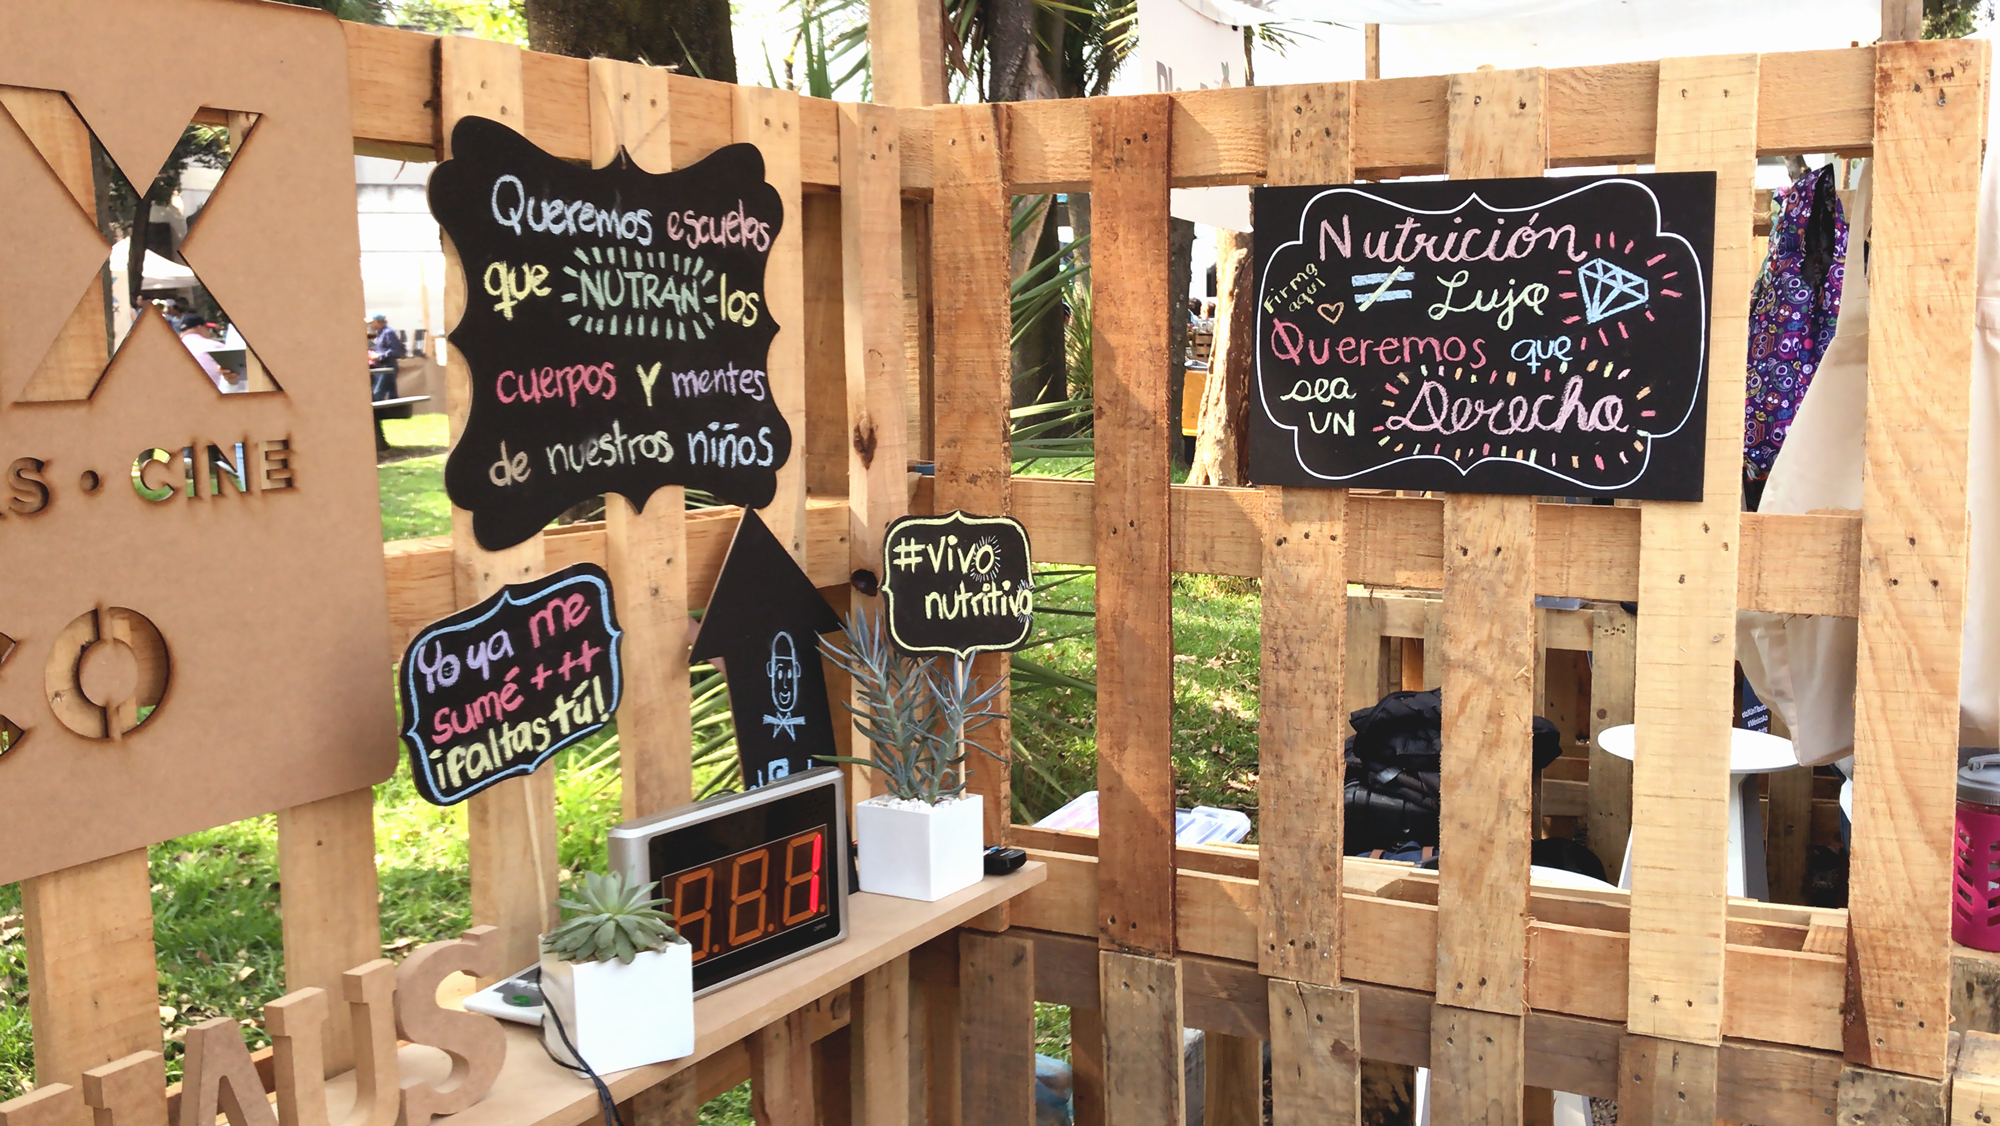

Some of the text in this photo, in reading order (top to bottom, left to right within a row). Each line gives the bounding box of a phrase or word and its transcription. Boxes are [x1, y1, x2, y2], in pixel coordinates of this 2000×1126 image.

[491, 173, 771, 252] Queremos escuelas
[1318, 212, 1588, 263] Nutrición
[483, 260, 760, 327] que NUTRAN los
[1263, 263, 1318, 315] Firma
[1428, 269, 1550, 331] Lujo
[1271, 318, 1574, 374] Queremos que
[496, 361, 617, 407] cuerpos
[671, 361, 766, 401] mentes
[1279, 376, 1357, 403] sea
[1385, 375, 1630, 436] Derecho
[1308, 409, 1356, 437] UN
[0, 438, 294, 516] S CINE
[489, 420, 774, 488] de nuestros niños
[924, 579, 1034, 620] nutritivo
[417, 592, 592, 694] Yo ya me
[431, 665, 525, 745] sumé
